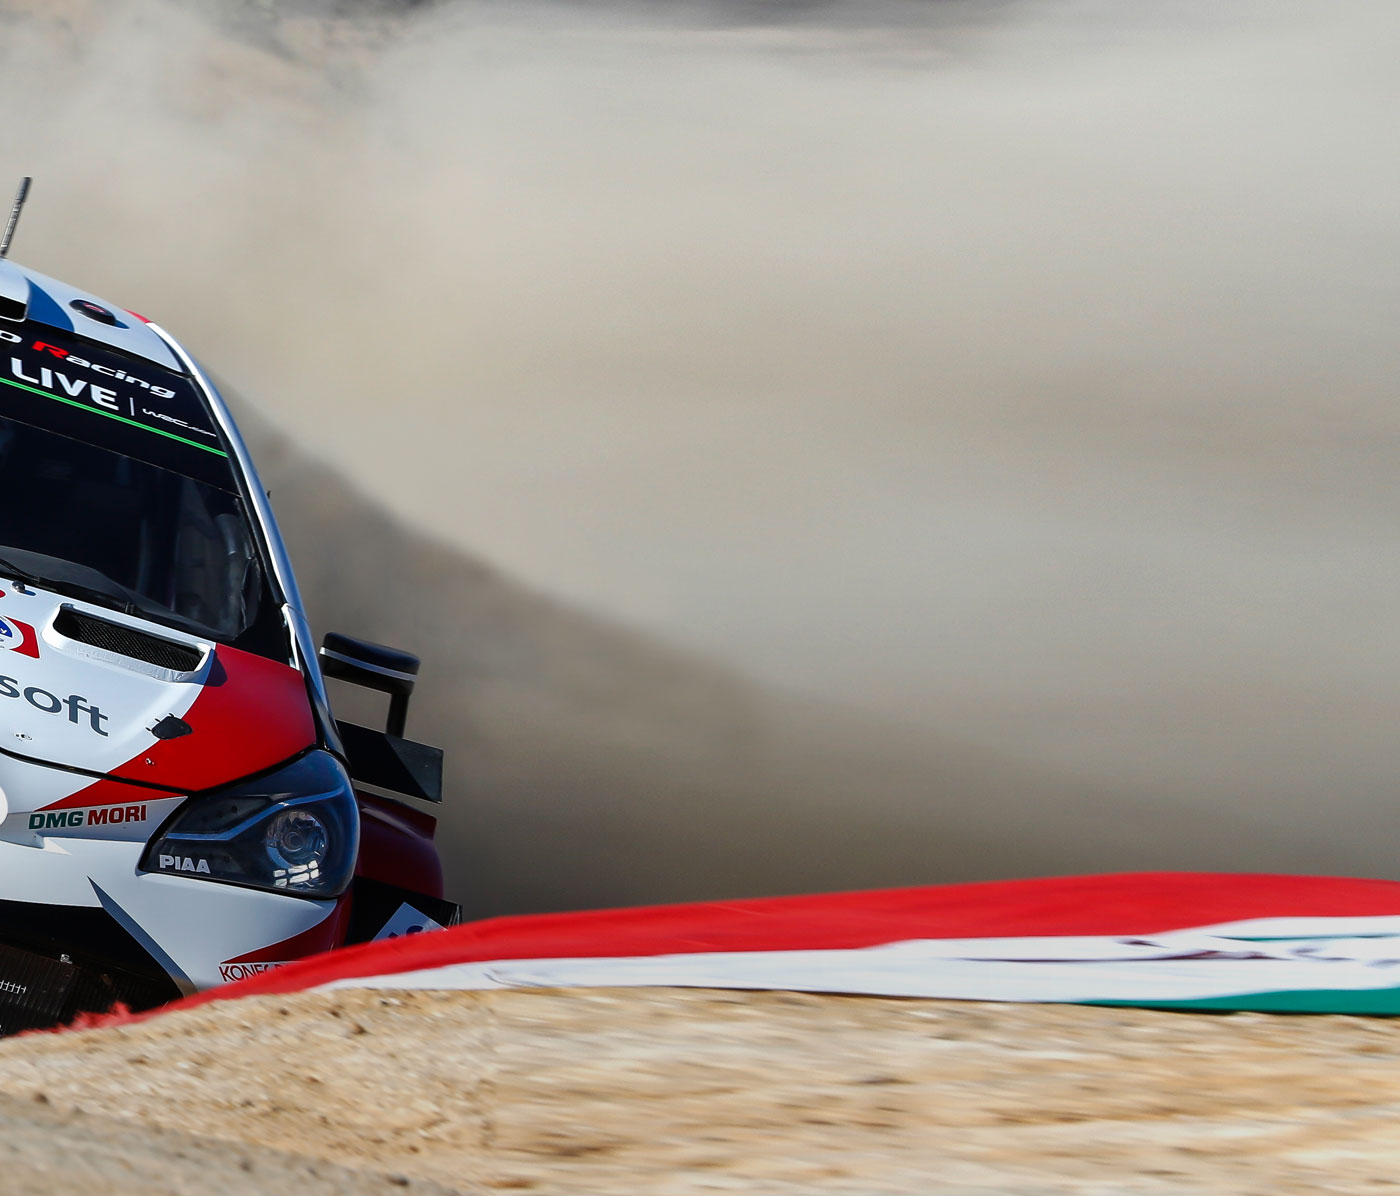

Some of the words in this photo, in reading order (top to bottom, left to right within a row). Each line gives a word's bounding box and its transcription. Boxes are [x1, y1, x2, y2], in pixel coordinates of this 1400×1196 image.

[11, 357, 119, 411] LIVE
[32, 340, 176, 399] Racing
[28, 811, 84, 830] DMG
[87, 805, 147, 825] MORI
[159, 854, 211, 874] PIAA
